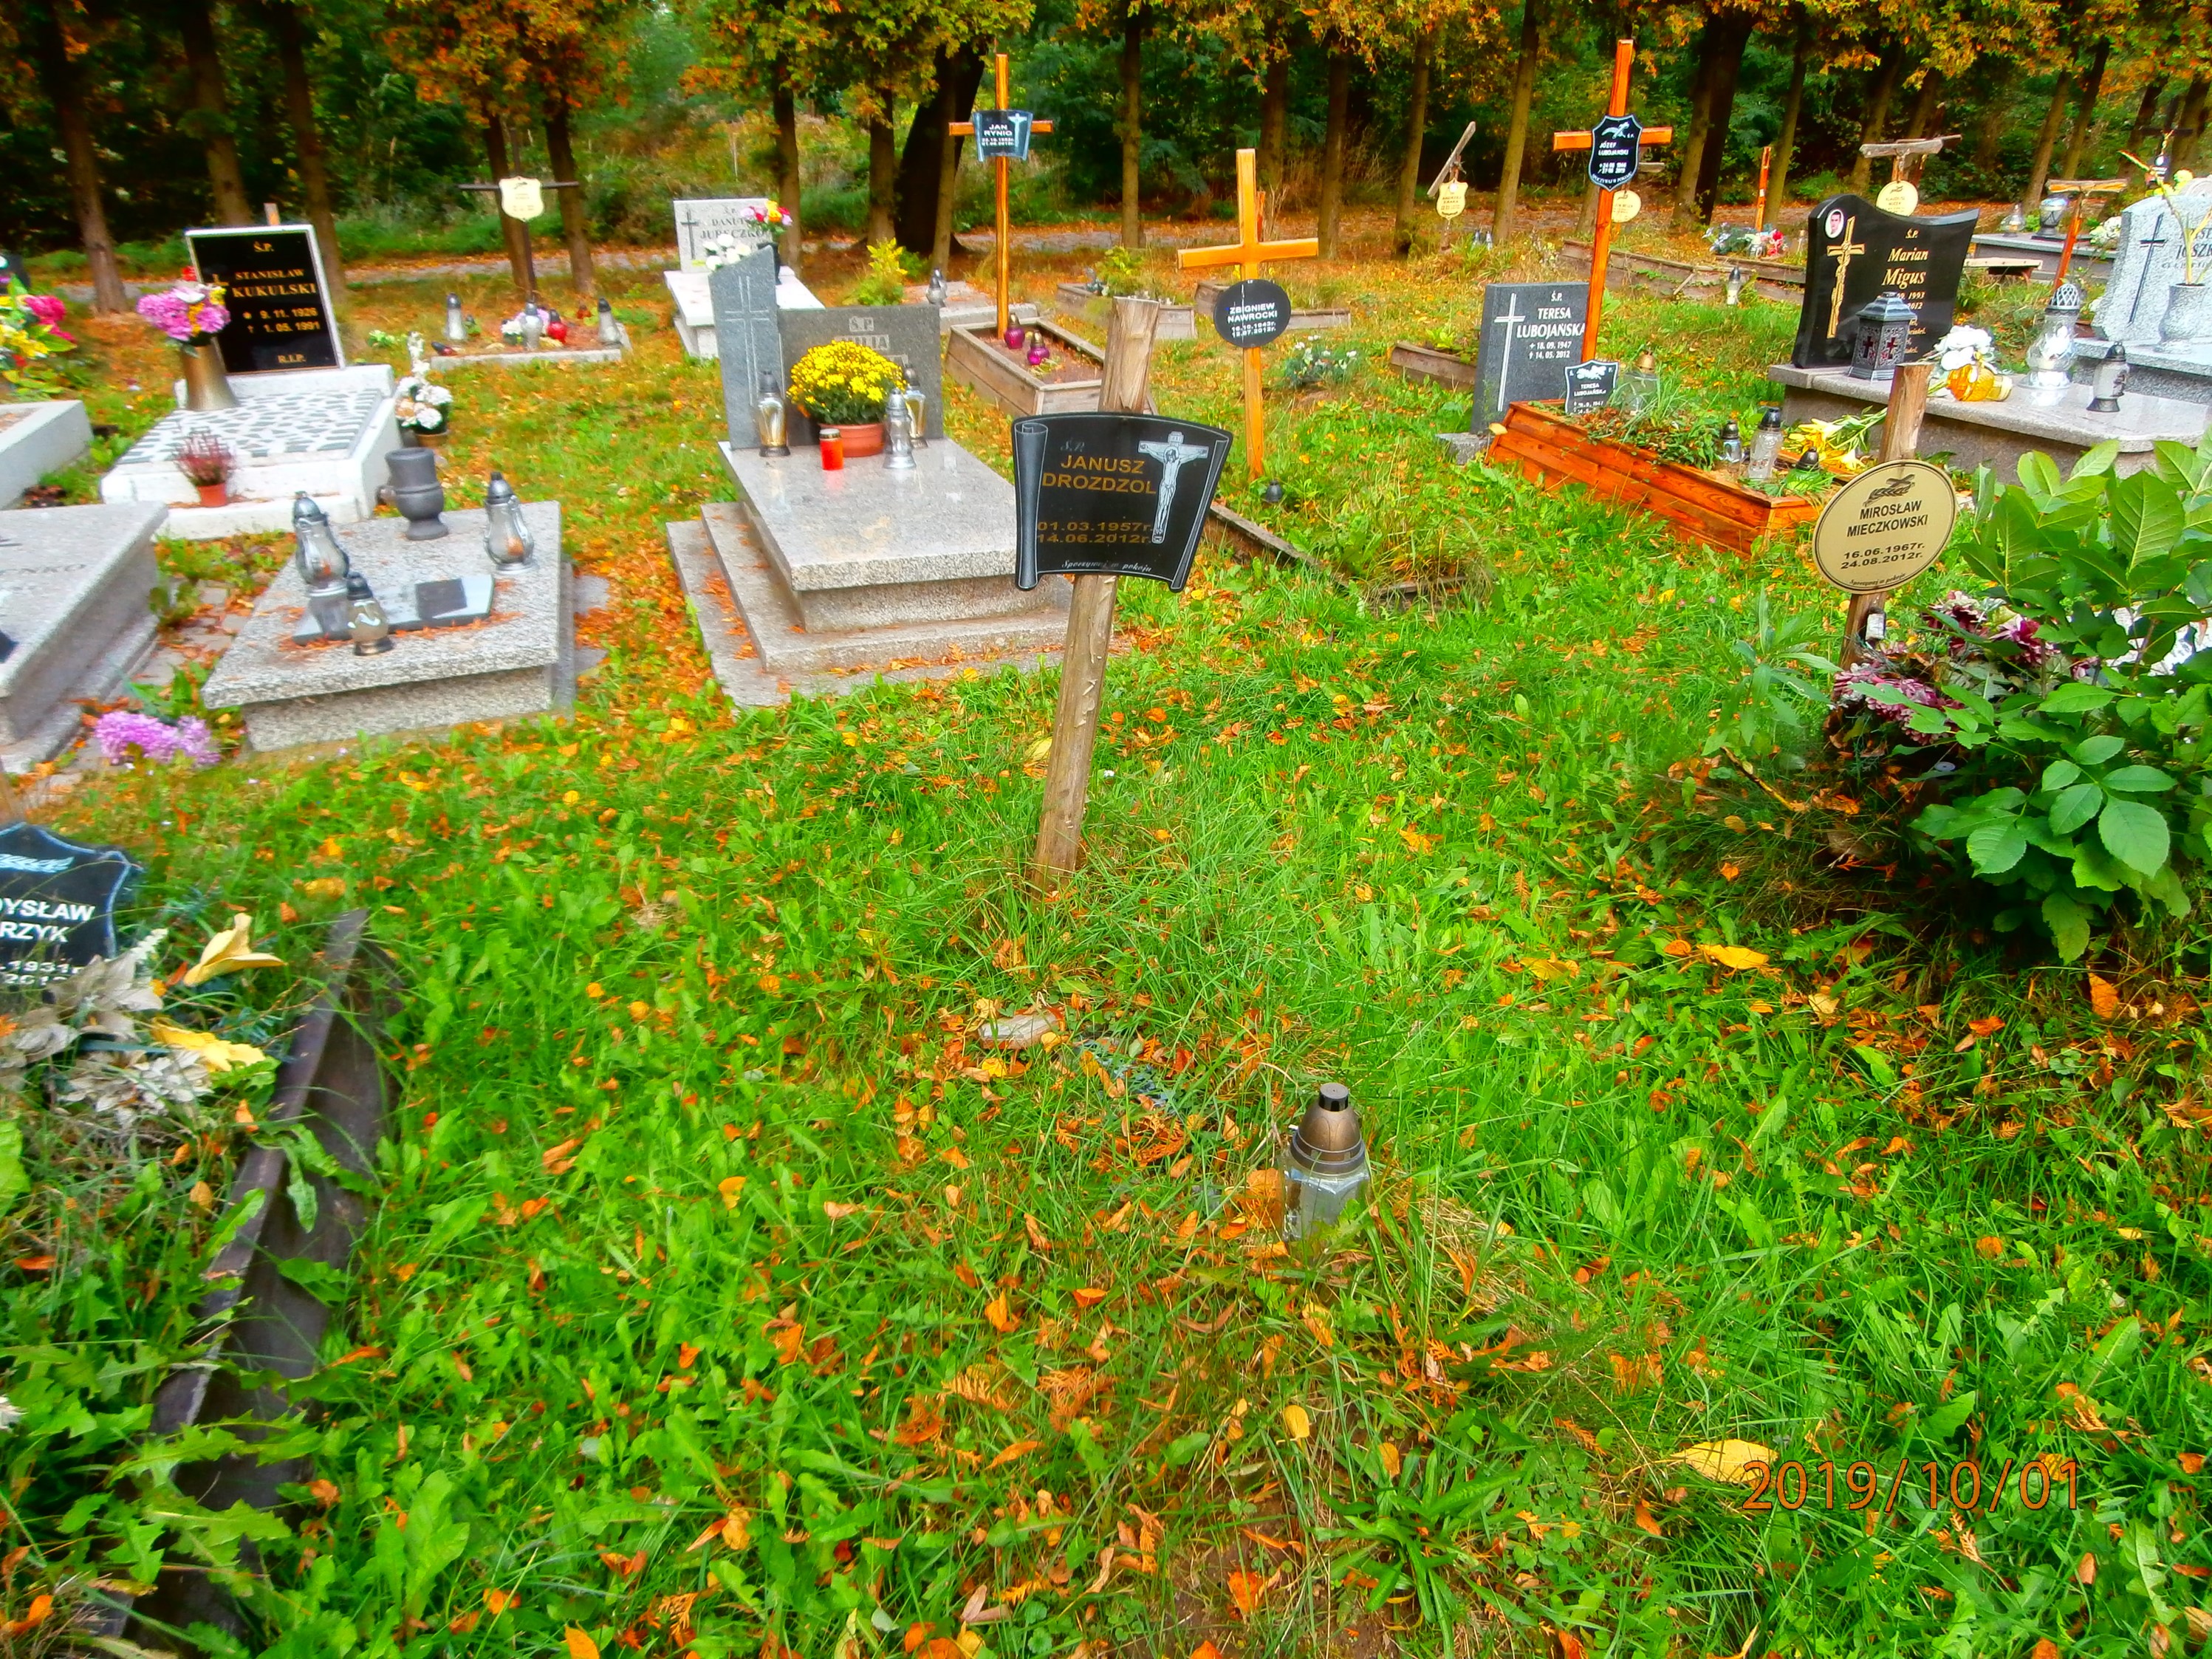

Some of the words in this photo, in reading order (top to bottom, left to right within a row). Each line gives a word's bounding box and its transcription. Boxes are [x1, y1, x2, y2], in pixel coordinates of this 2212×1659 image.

[1599, 140, 1617, 149] JÓZEF
[1887, 247, 1929, 262] Marian
[234, 268, 305, 281] STANISŁAW
[1881, 268, 1927, 290] Migus
[231, 283, 317, 298] KUKULSKI
[1229, 302, 1275, 315] ZBIGNIEW
[1538, 307, 1572, 320] TERESA
[1227, 310, 1278, 324] NAWROCKI
[1516, 322, 1586, 340] LUBOJAŃSKA
[1558, 341, 1572, 349] 1947
[1556, 350, 1570, 358] 2012
[1060, 454, 1146, 474] JANUSZ
[1041, 473, 1157, 495] DROZDZOL
[1859, 500, 1922, 520] MIROSŁAW
[1036, 521, 1153, 532] 01.03.1957r.
[1846, 515, 1928, 538] MIECZKOWSKI
[1037, 533, 1152, 544] 14.06.2012r.
[1843, 541, 1925, 560] 16.06.1967r.
[1122, 563, 1152, 572] pokoju
[1840, 552, 1923, 569] 24.08.2012r.
[0, 897, 96, 922] YSŁAW
